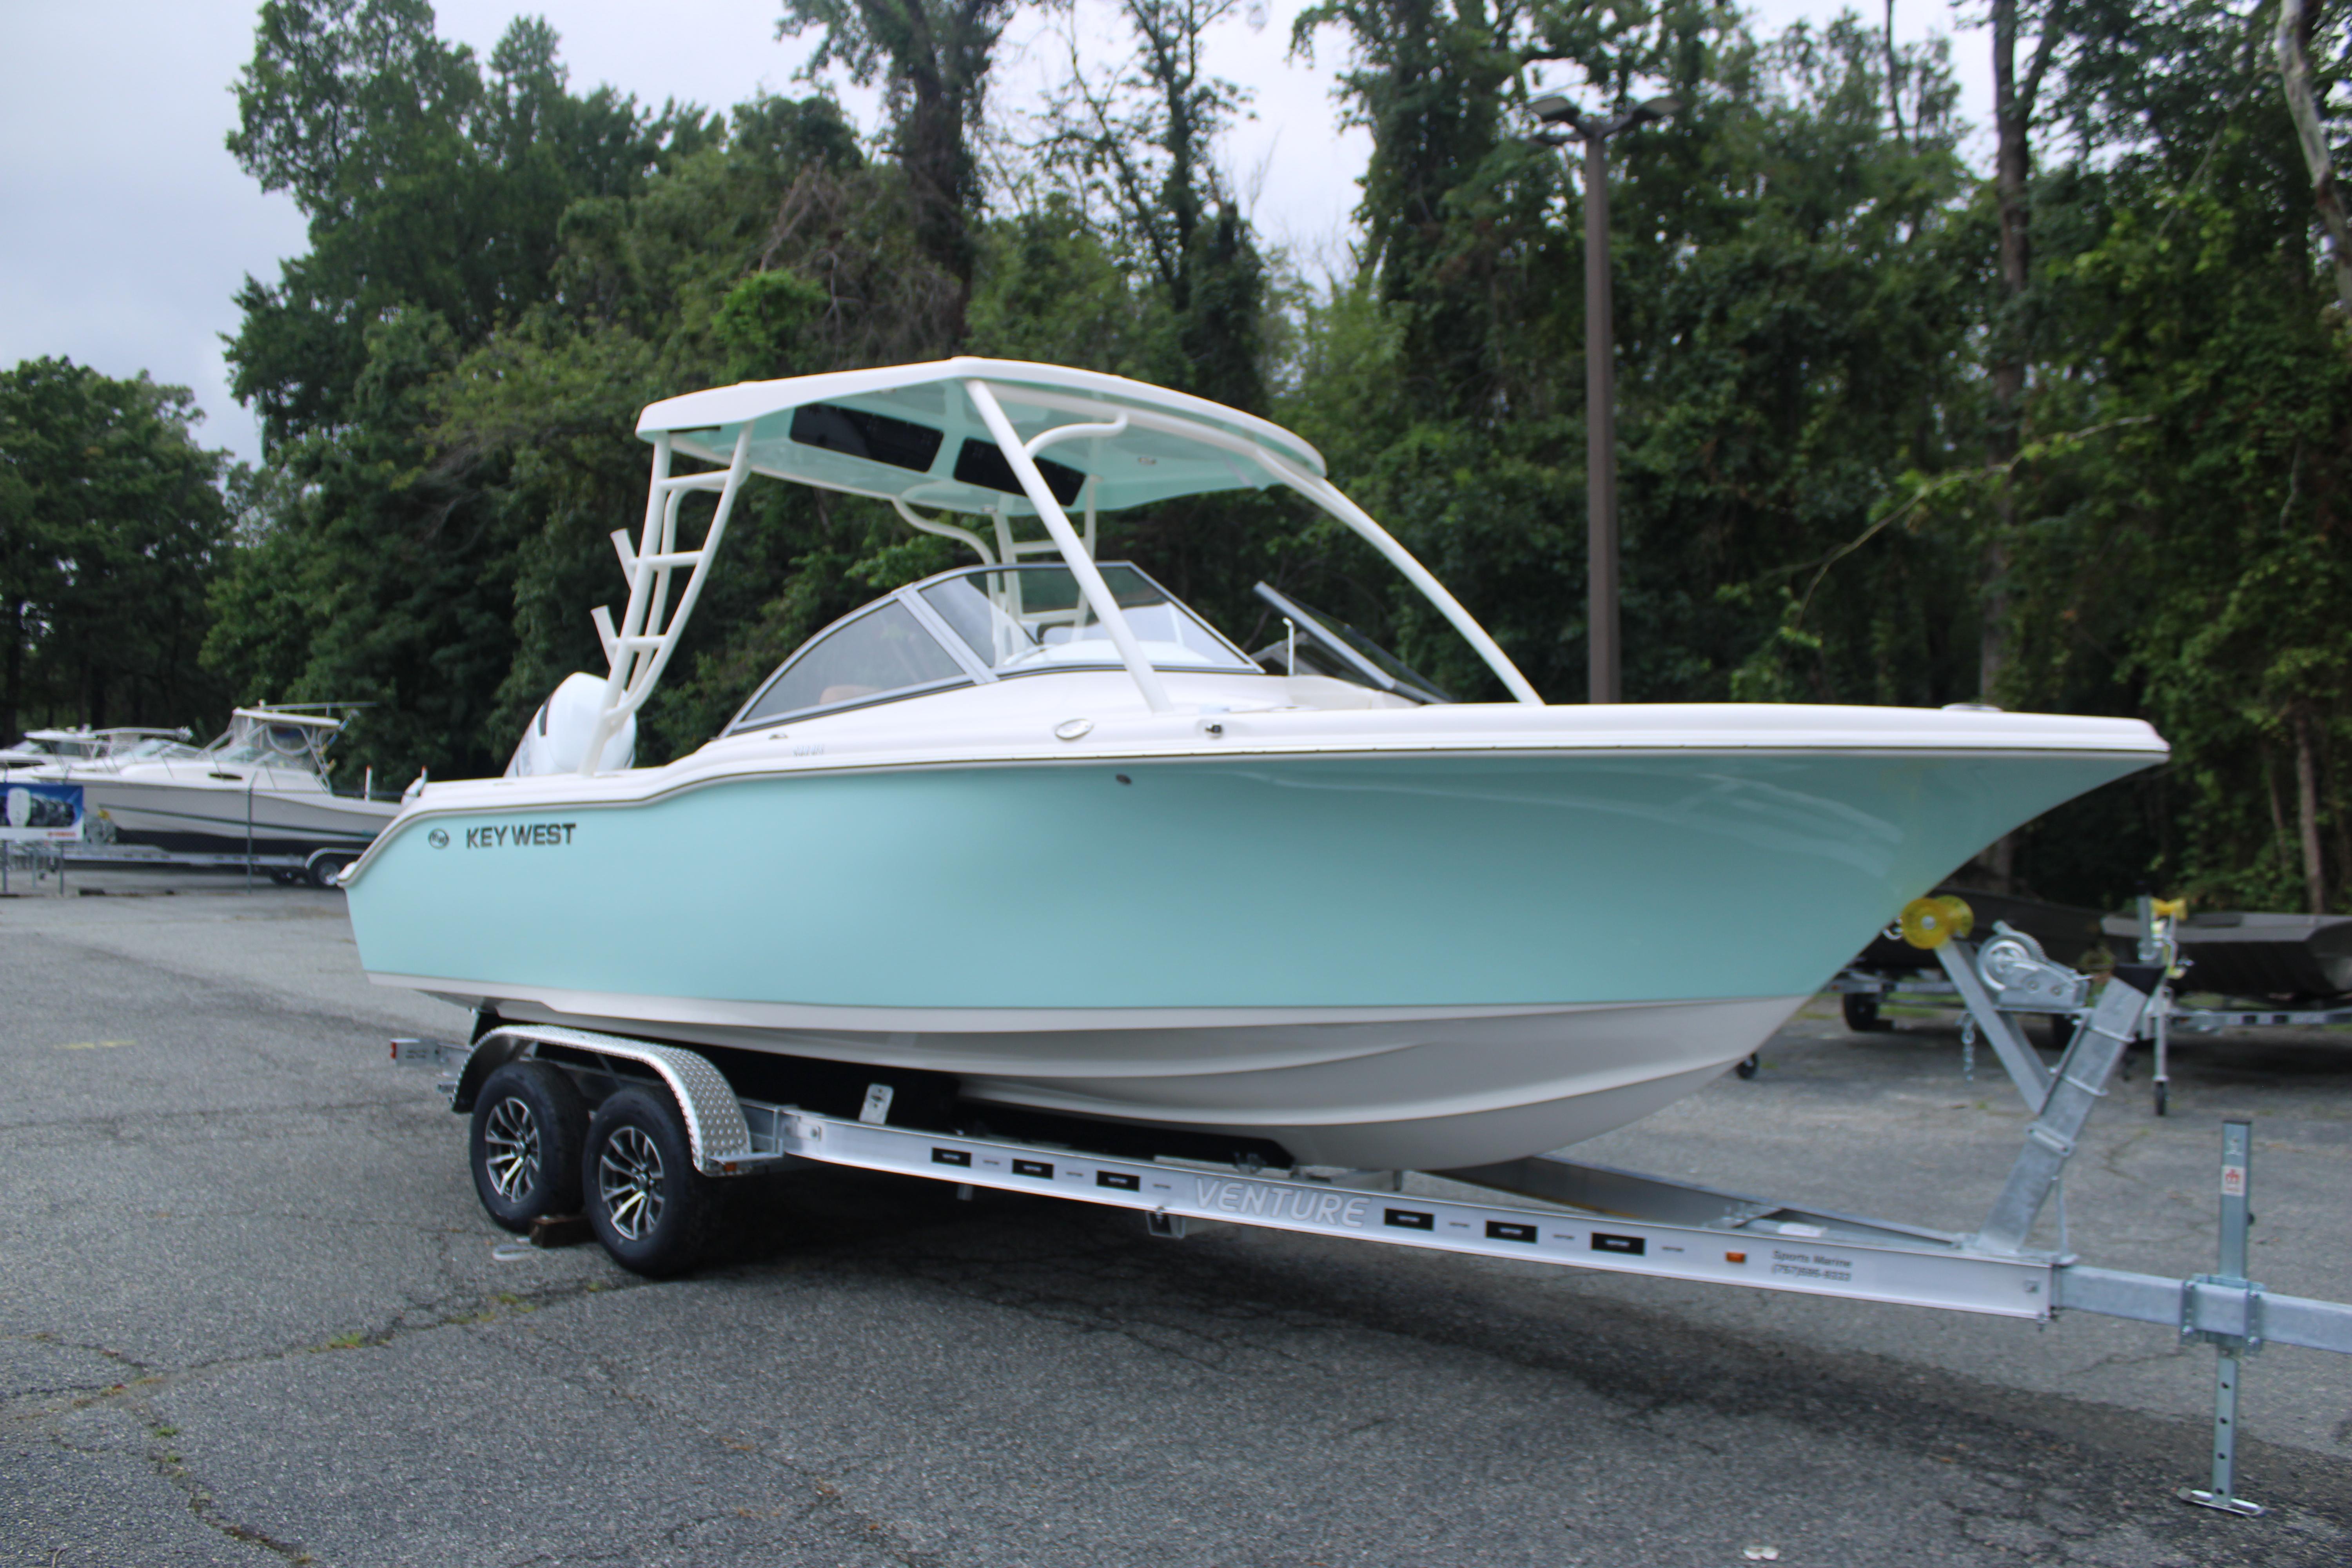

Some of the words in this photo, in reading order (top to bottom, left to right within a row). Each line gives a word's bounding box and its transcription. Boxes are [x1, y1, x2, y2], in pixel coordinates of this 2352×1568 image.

[466, 826, 508, 848] KEY
[511, 823, 576, 846] WEST
[1196, 1176, 1371, 1229] VENTURE
[1772, 1249, 1809, 1263] Sports
[1813, 1255, 1852, 1268] Marine
